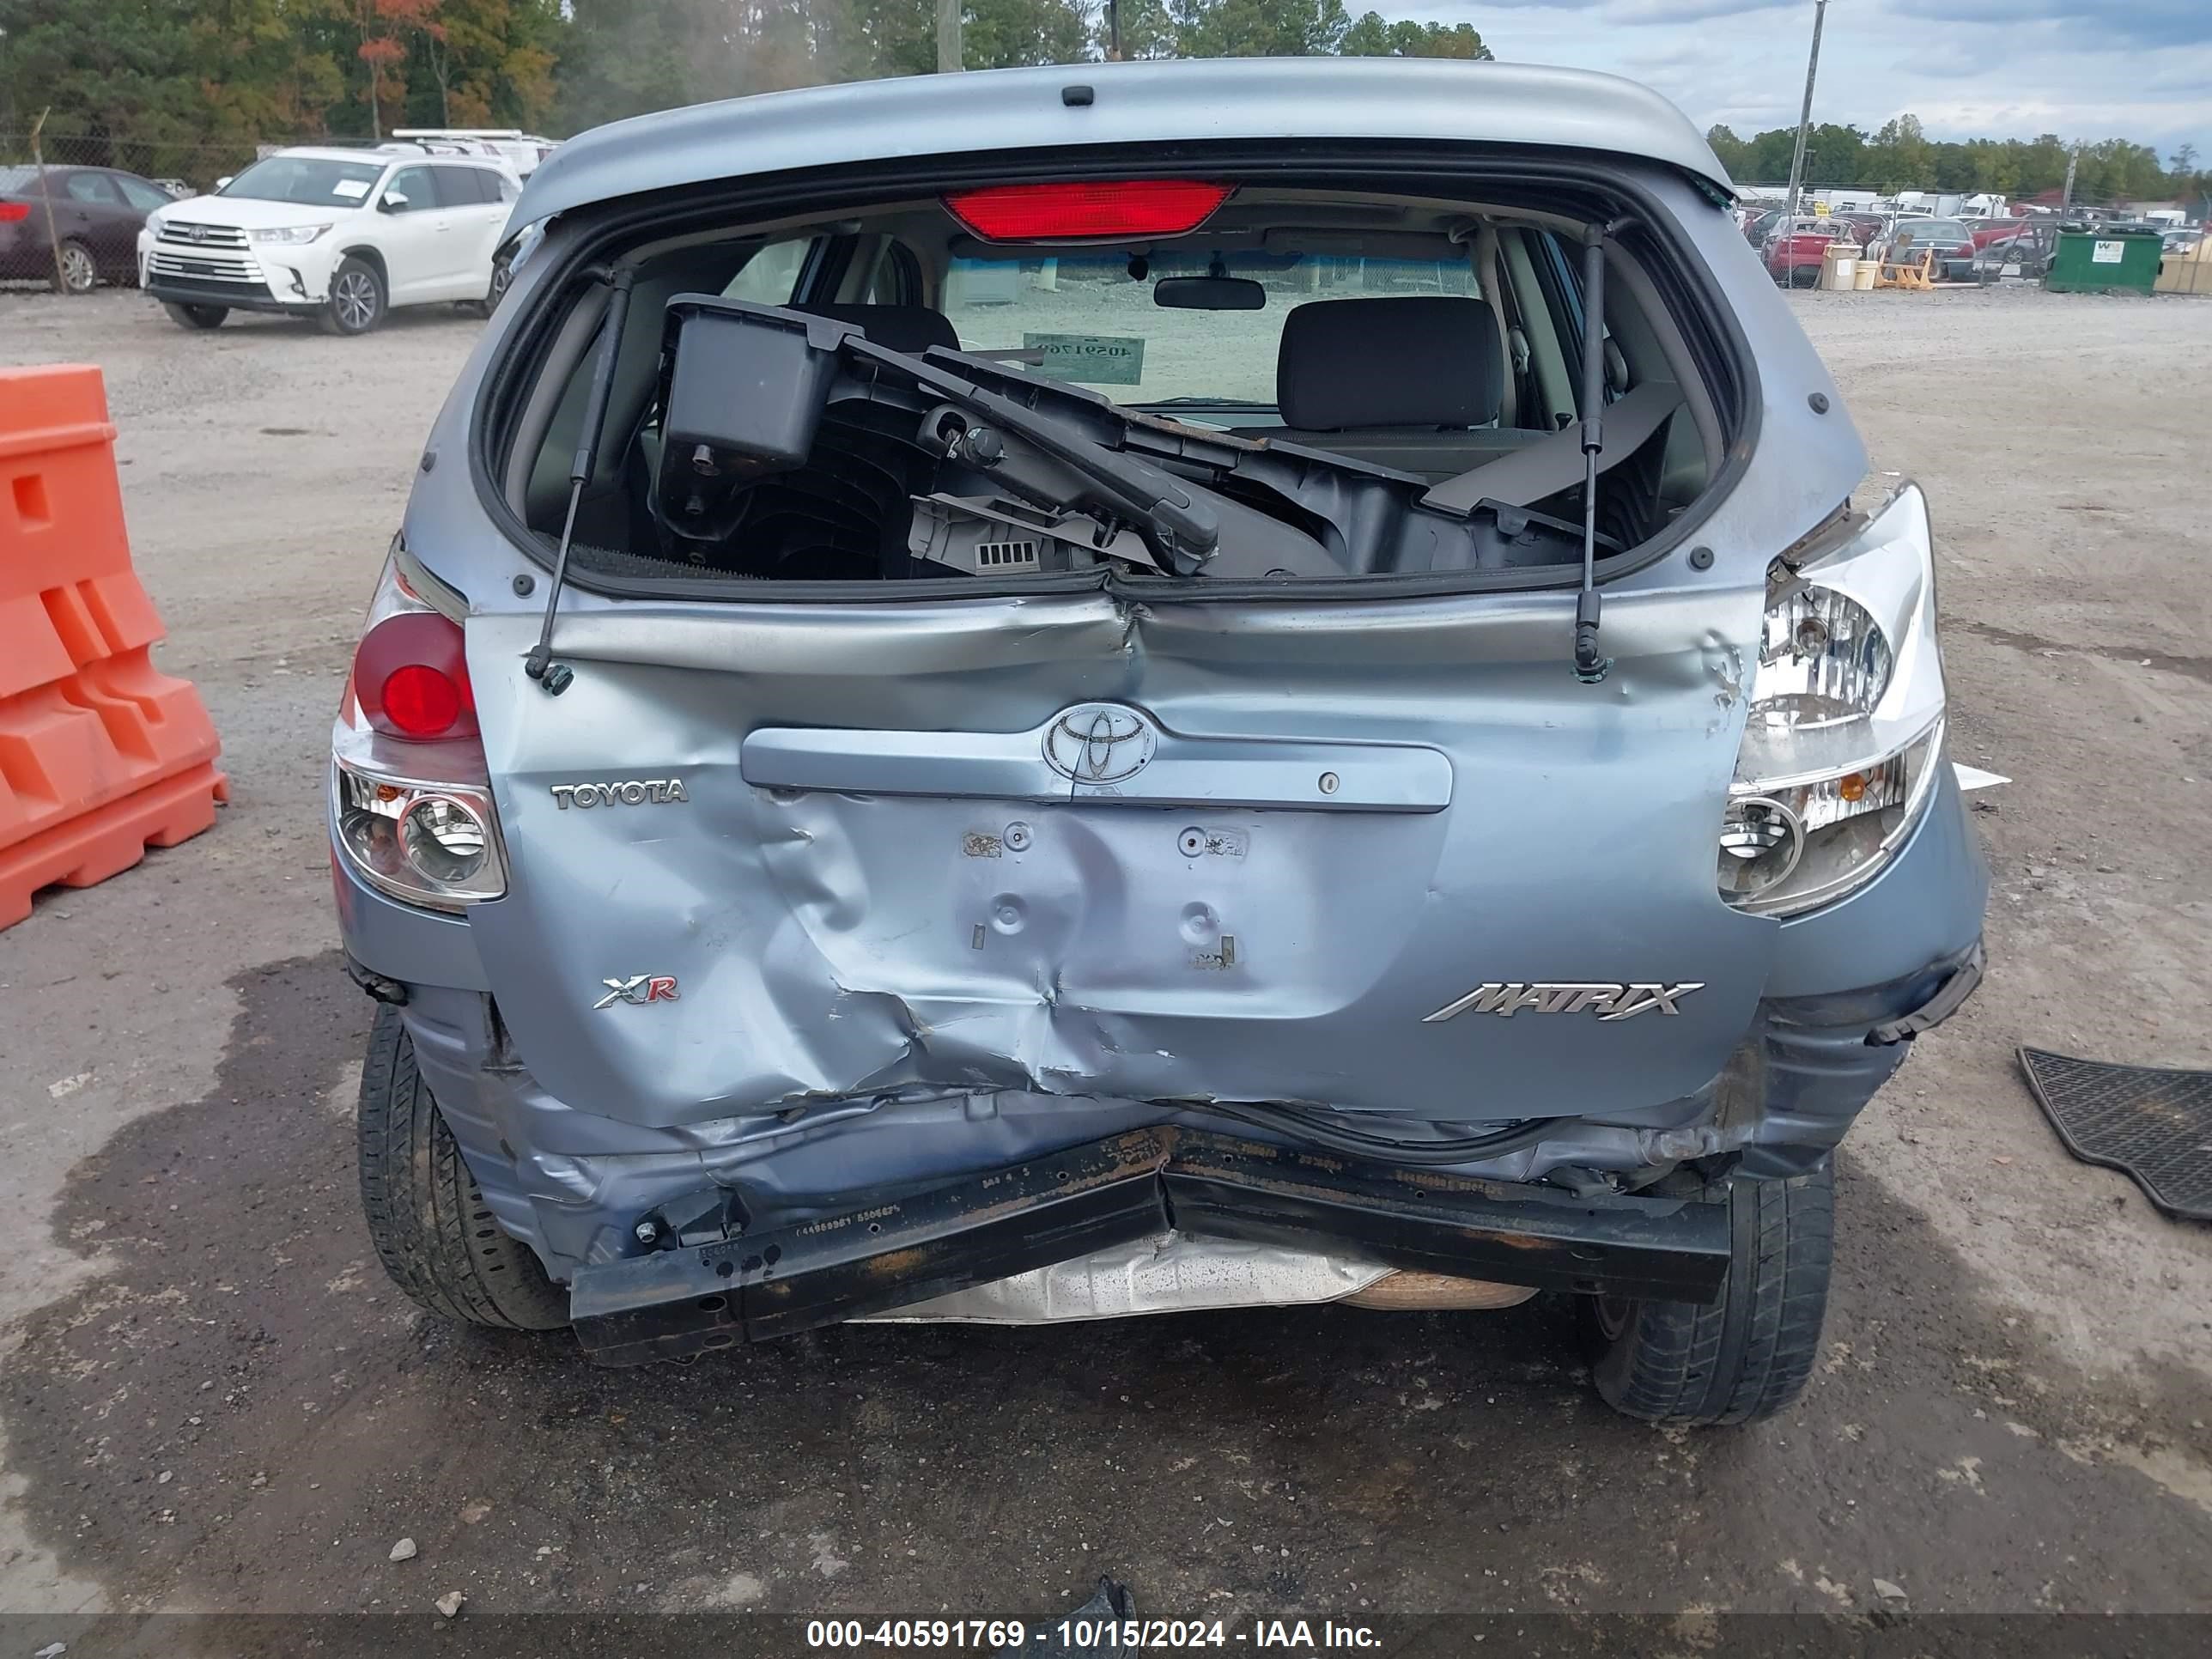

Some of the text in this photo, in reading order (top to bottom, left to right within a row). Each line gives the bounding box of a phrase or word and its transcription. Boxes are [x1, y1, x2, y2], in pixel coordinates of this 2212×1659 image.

[550, 777, 689, 810] TOYOTA
[592, 973, 681, 1010] XR
[1421, 982, 1705, 1022] MATRIX
